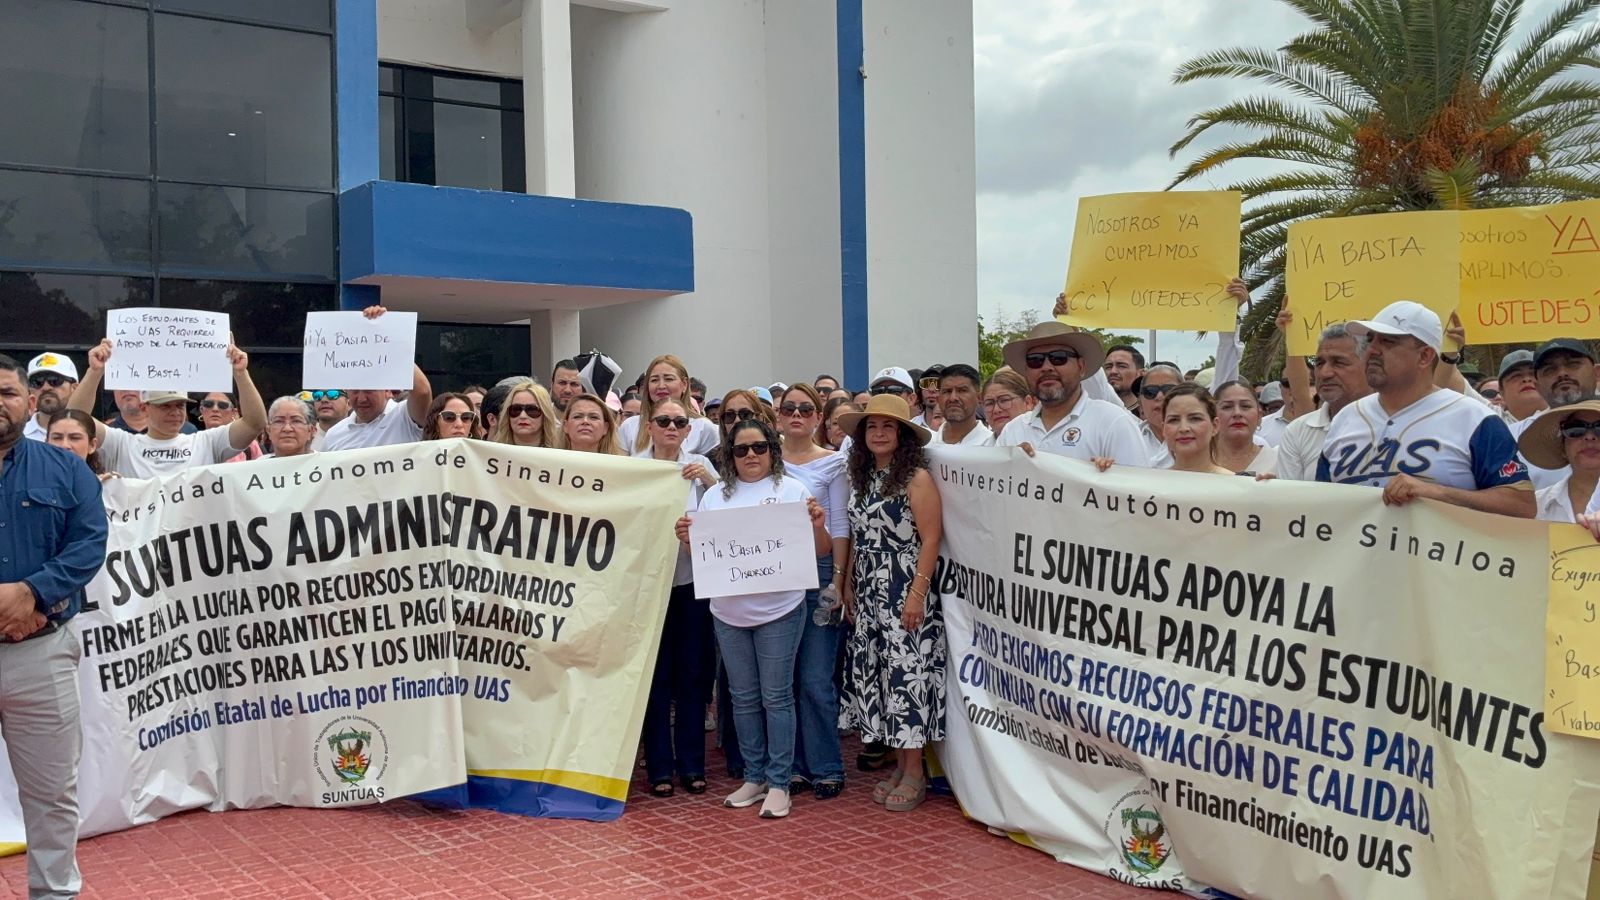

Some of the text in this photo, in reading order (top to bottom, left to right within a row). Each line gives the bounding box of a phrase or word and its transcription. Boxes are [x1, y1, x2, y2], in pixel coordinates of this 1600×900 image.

[1086, 208, 1198, 239] NOSOTROS YA
[1105, 244, 1200, 261] CUMPLIMOS
[1342, 236, 1426, 266] BASTA
[1459, 214, 1600, 250] osotros YA
[1324, 280, 1355, 301] DE
[1459, 260, 1571, 280] MPLIMOS.
[138, 326, 160, 335] UAS
[246, 458, 414, 490] Autónoma
[435, 449, 466, 468] de
[486, 459, 604, 492] Sinaloa
[1334, 438, 1440, 478] UAS
[106, 517, 272, 606] SUNTUAS
[286, 492, 616, 572] ADMINISTRATIVO
[766, 538, 786, 553] DE
[940, 464, 1516, 578] Universidad Autónoma de Sinaloa
[82, 616, 146, 658] FIRME
[150, 608, 166, 639] EN
[167, 600, 189, 630] LA
[193, 588, 254, 621] LUCHA
[257, 581, 301, 612] POR
[307, 565, 413, 606] RECURSOS
[1014, 532, 1336, 637] EL SUNTUAS APOYA LA
[98, 634, 192, 692] FEDERALES
[197, 623, 232, 655] QUE
[236, 608, 367, 651] GARANTICEN
[373, 604, 395, 632] EL
[401, 596, 446, 627] PAGO
[552, 616, 565, 642] Y
[127, 660, 247, 722] PRESTACIONES
[250, 652, 306, 684] PARA
[309, 645, 349, 675] LAS
[352, 644, 366, 669] Y
[372, 638, 408, 667] LOS
[1011, 582, 1147, 656] UNIVERSAL
[1156, 615, 1238, 677] PARA
[1244, 634, 1307, 692] LOS
[1317, 648, 1547, 769] ESTUDIANTES
[138, 706, 211, 751] Comisión
[271, 694, 294, 718] de
[296, 684, 350, 714] Lucha
[356, 682, 387, 709] por
[474, 675, 511, 702] UAS
[1001, 631, 1075, 687] EXIGIMOS
[1078, 657, 1195, 720] RECURSOS
[1199, 688, 1355, 761] FEDERALES
[1364, 726, 1434, 789] PARA
[959, 654, 1434, 843] CONTINUAR CON SU FORMACIÓN DE CALIDAD.
[322, 786, 385, 804] SUNTUAS
[964, 696, 1026, 742] Comisión
[1026, 721, 1072, 760] Estatal
[1076, 737, 1098, 765] de
[1176, 779, 1348, 861] Financiamiento
[1357, 833, 1412, 879] UAS
